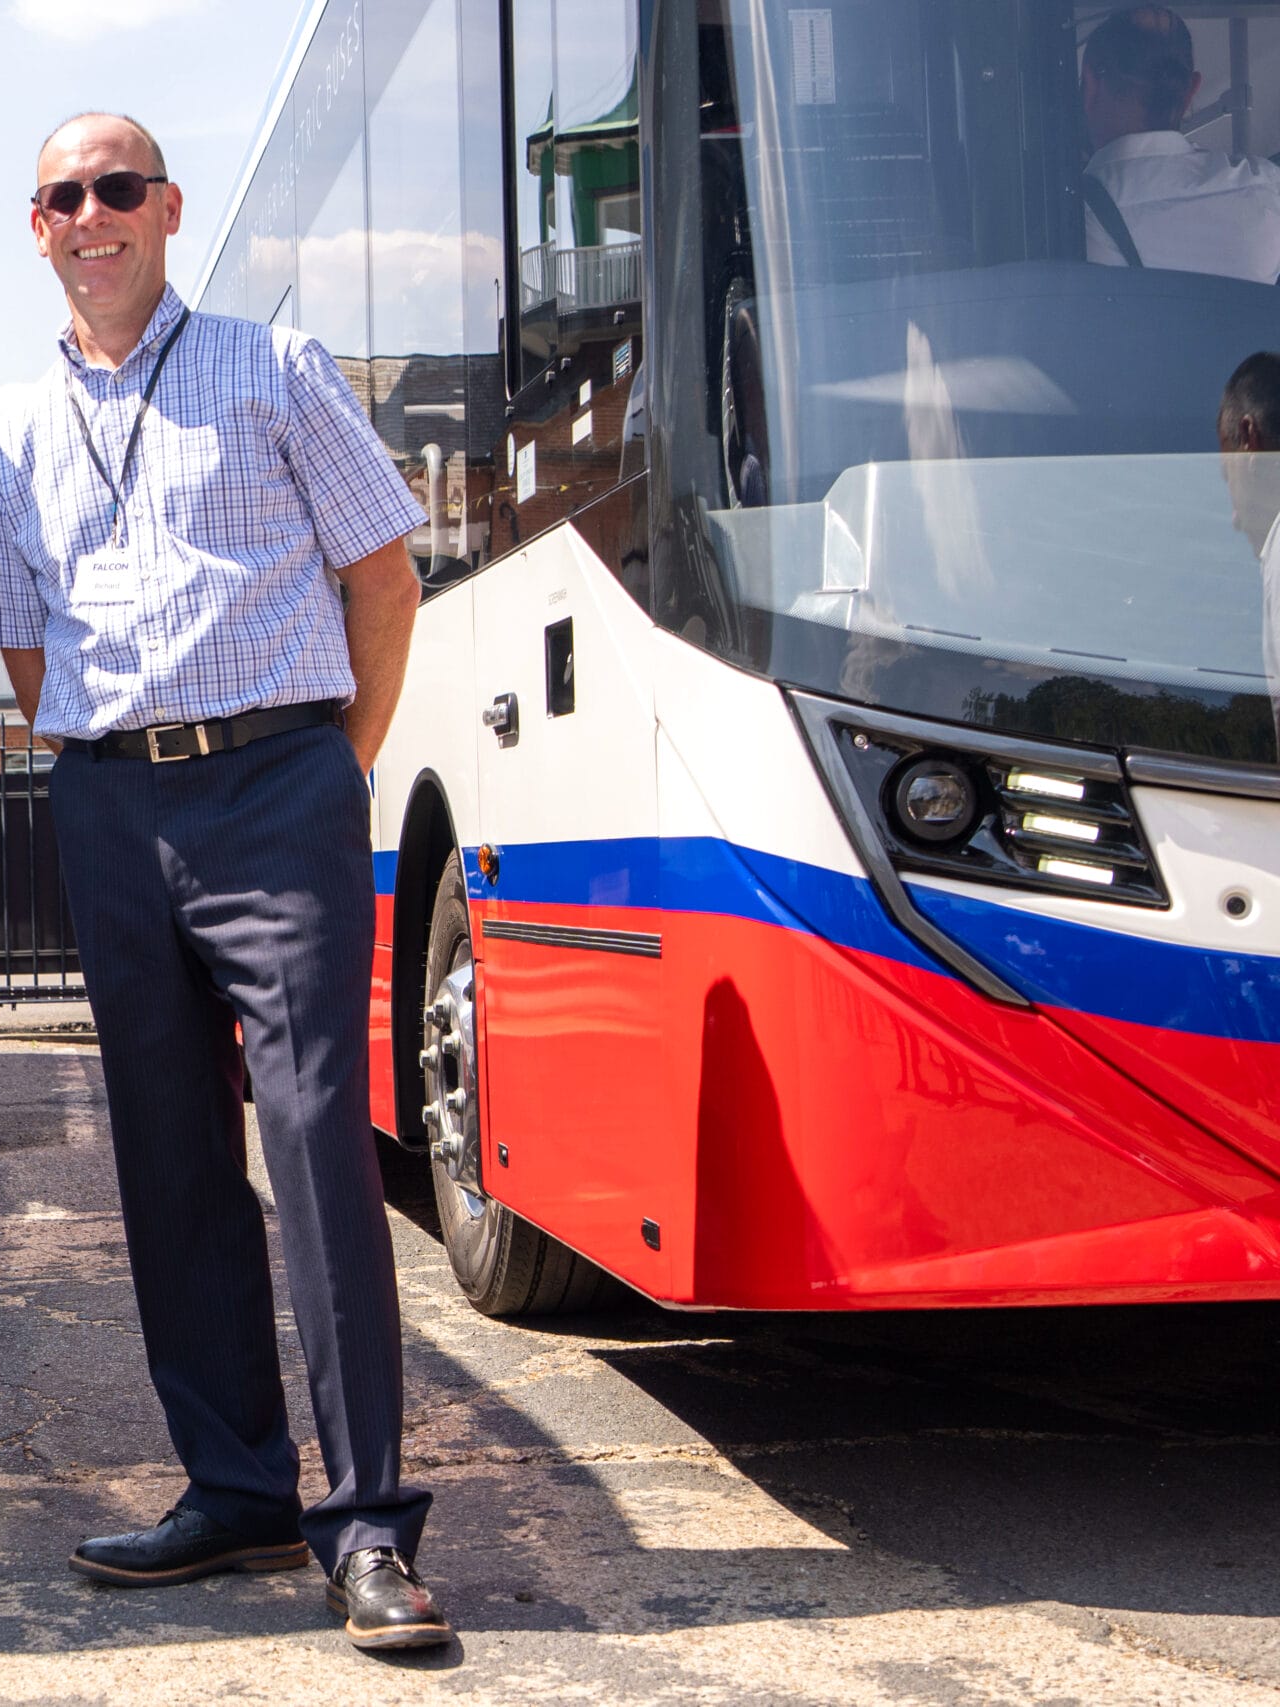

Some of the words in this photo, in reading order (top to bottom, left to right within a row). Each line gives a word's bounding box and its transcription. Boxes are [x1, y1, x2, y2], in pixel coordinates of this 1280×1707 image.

[279, 84, 322, 207] ELECTRIC
[325, 1, 360, 112] BUSES
[92, 563, 129, 571] FALCON
